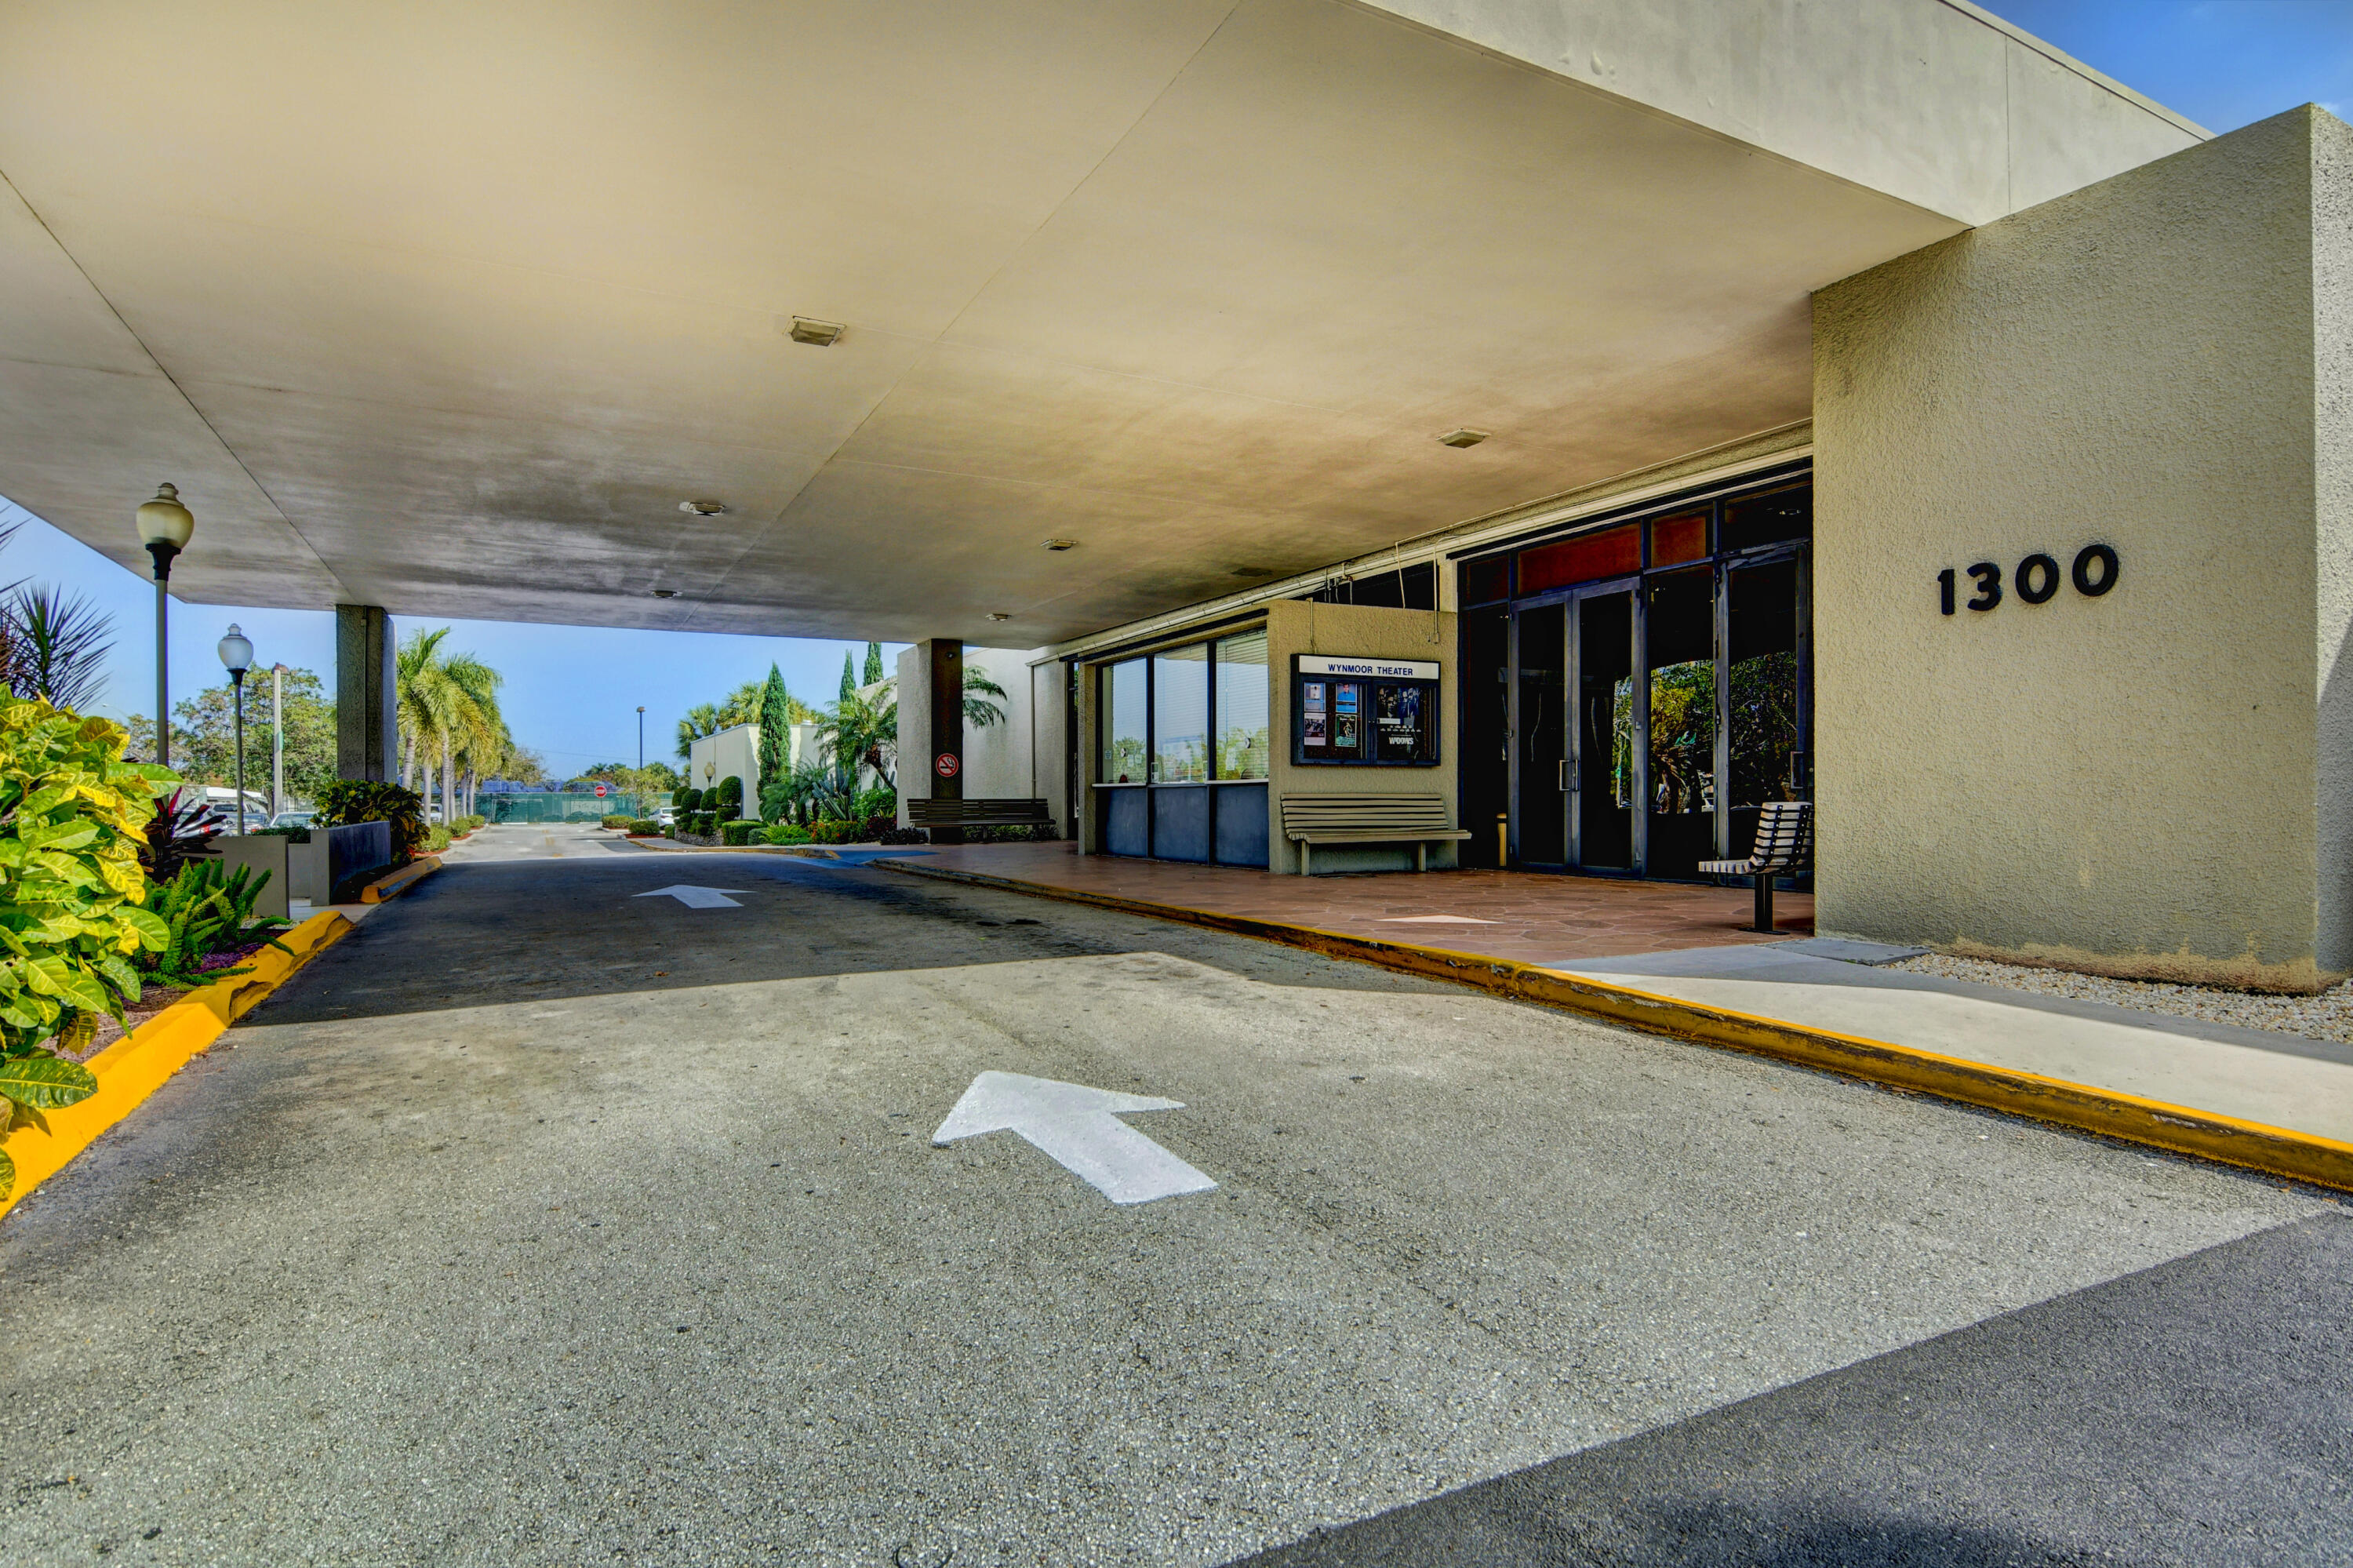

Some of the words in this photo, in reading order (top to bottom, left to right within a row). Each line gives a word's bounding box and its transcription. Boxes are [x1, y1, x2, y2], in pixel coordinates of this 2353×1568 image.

[1937, 543, 2119, 616] 1300
[1328, 664, 1373, 674] WYNMOOR
[1377, 666, 1413, 676] THEATER
